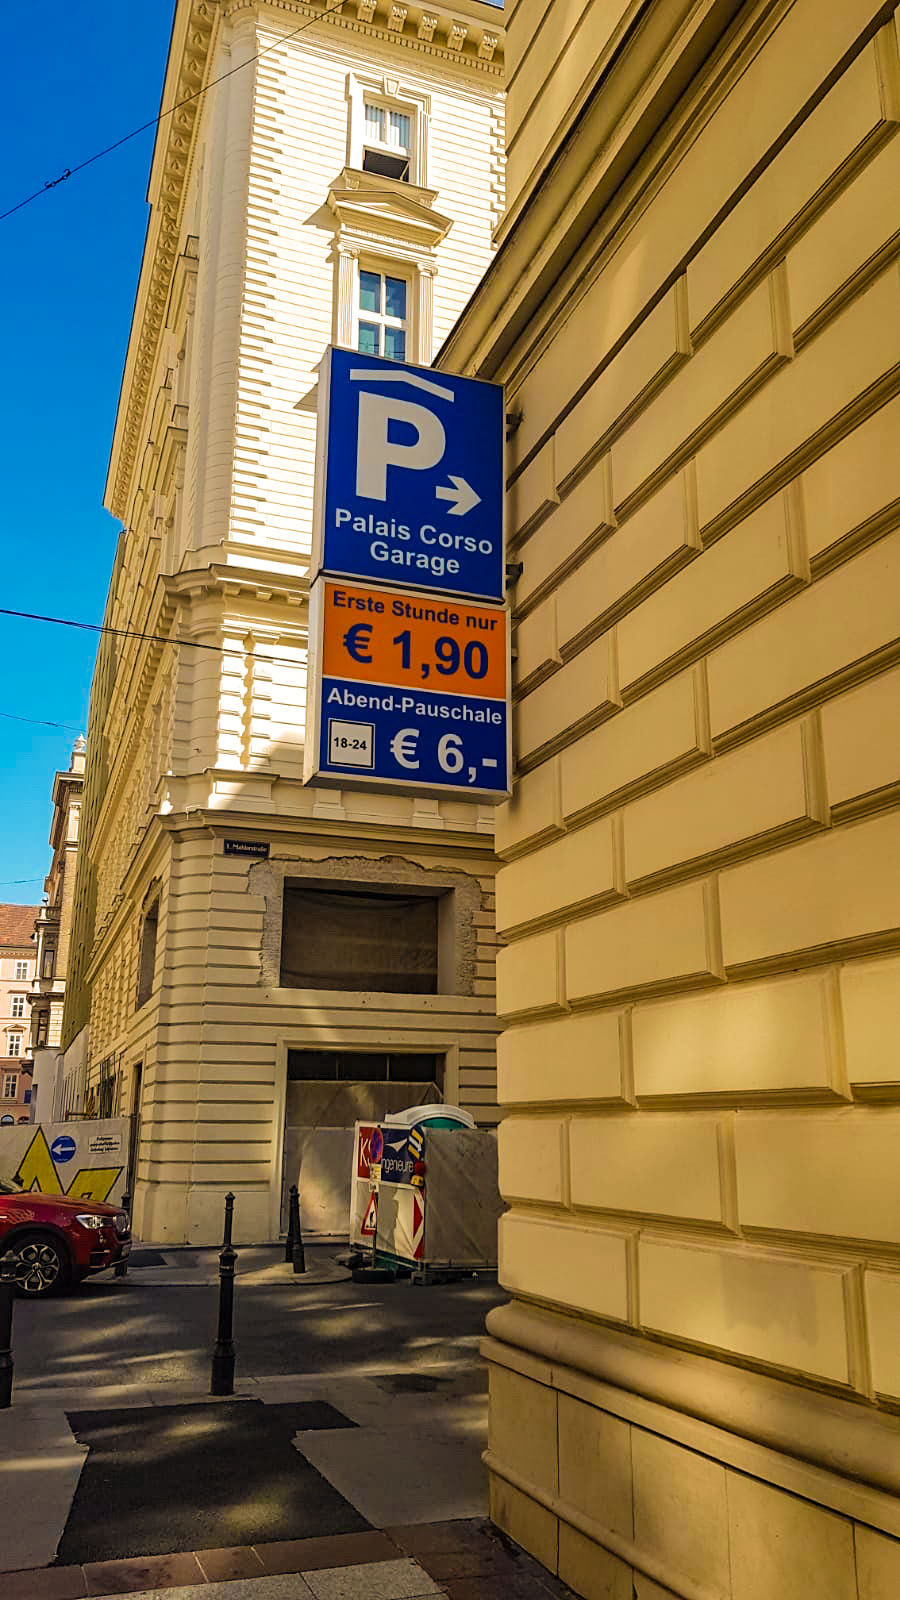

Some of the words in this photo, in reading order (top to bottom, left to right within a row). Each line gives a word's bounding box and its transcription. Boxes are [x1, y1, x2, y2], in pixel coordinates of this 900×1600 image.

[355, 390, 446, 502] P
[335, 508, 411, 541] Palais
[419, 524, 493, 555] Corso
[370, 541, 460, 576] Garage
[333, 590, 385, 613] Erste
[391, 600, 459, 625] Stunde
[466, 614, 498, 631] nur
[343, 623, 373, 664] €
[393, 630, 489, 680] 1,90
[327, 687, 502, 725] Abend-Pauschale
[333, 736, 367, 751] 18-24
[390, 728, 420, 769] €
[437, 733, 498, 783] 6,-
[381, 1157, 414, 1173] ngenieure
